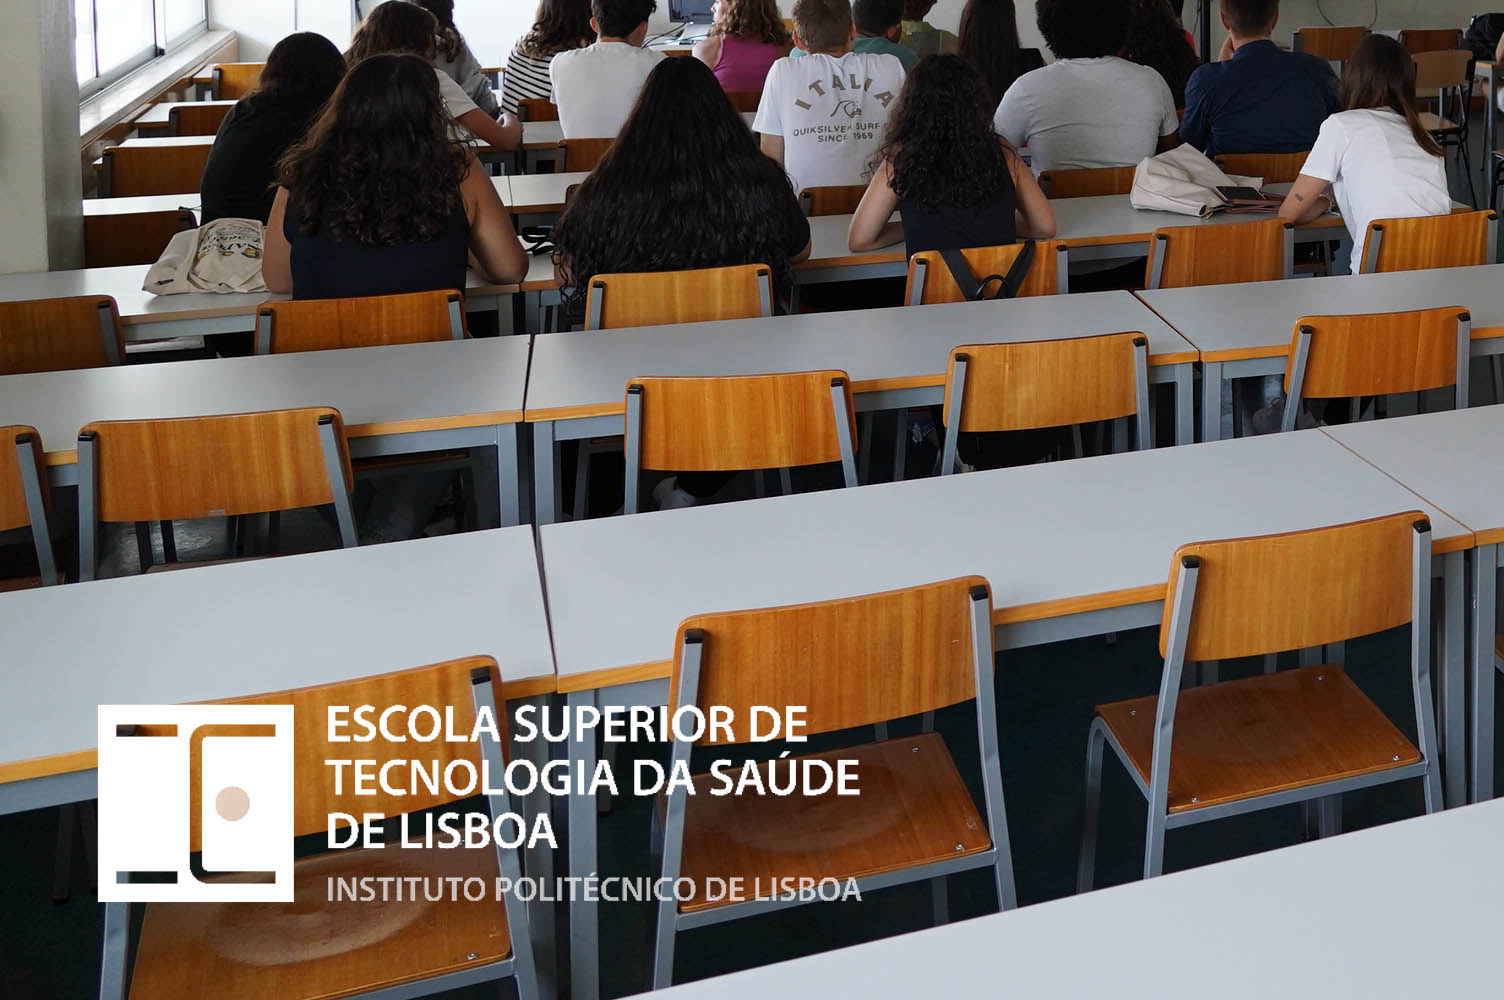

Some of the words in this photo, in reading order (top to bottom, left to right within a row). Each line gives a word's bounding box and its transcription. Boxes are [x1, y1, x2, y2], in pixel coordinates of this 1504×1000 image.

[794, 73, 894, 111] ITALIA
[855, 122, 881, 131] SURF
[853, 132, 873, 140] 1969
